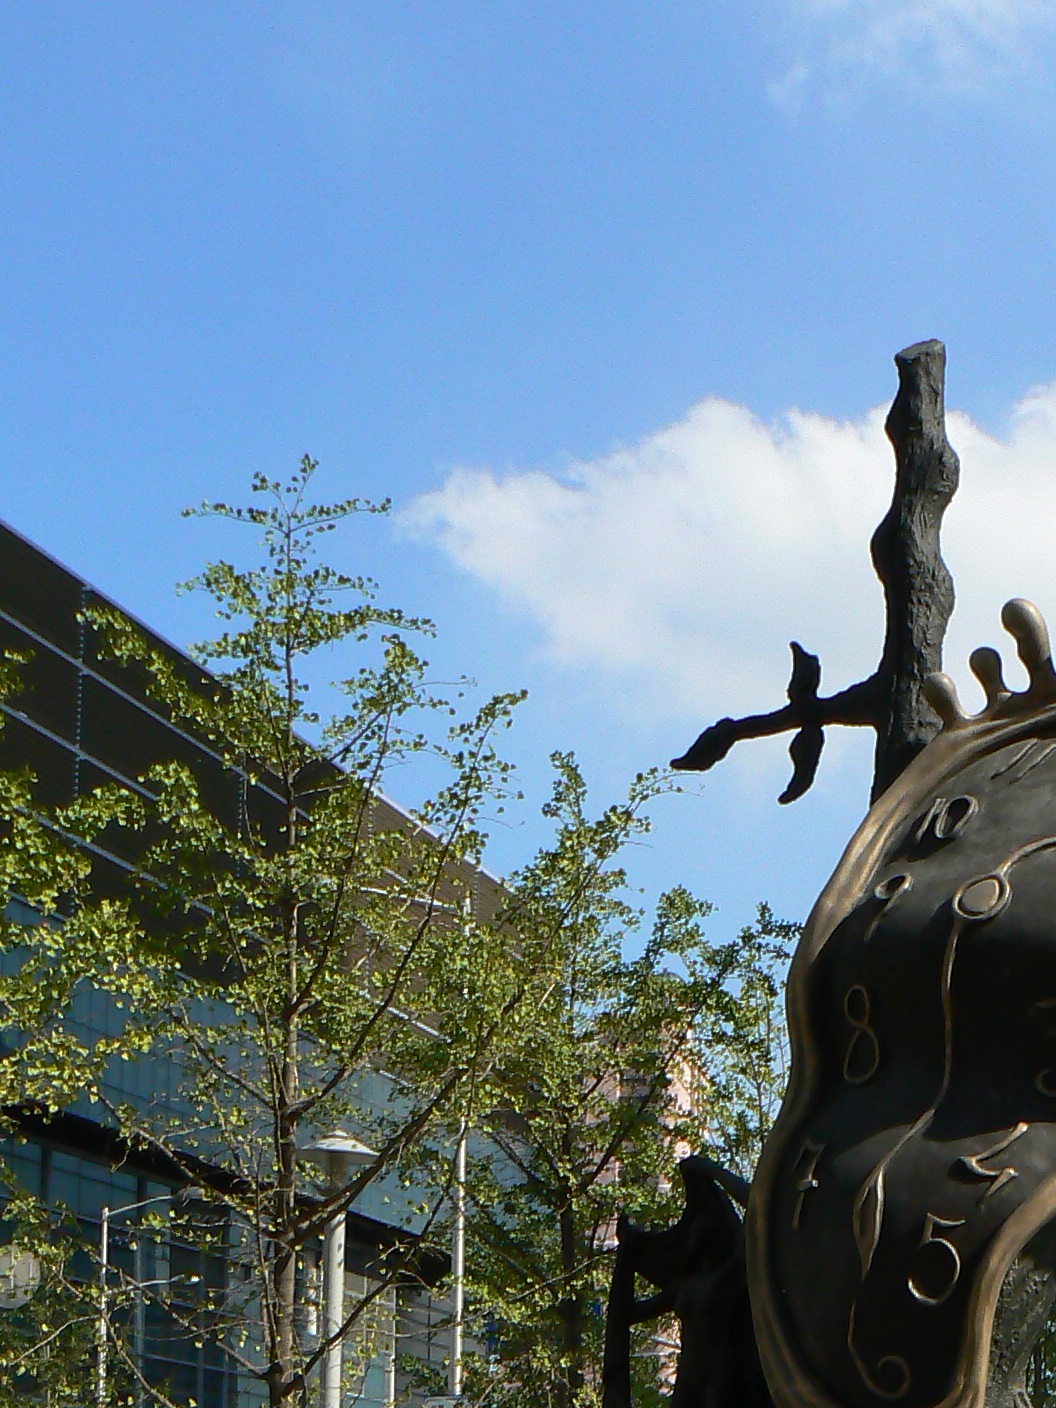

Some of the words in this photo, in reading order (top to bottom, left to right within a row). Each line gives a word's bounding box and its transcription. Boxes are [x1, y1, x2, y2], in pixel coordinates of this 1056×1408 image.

[915, 795, 979, 843] 10
[864, 872, 914, 943] 9
[842, 984, 881, 1085] 8
[791, 1138, 826, 1231] 7
[905, 1212, 966, 1307] 5
